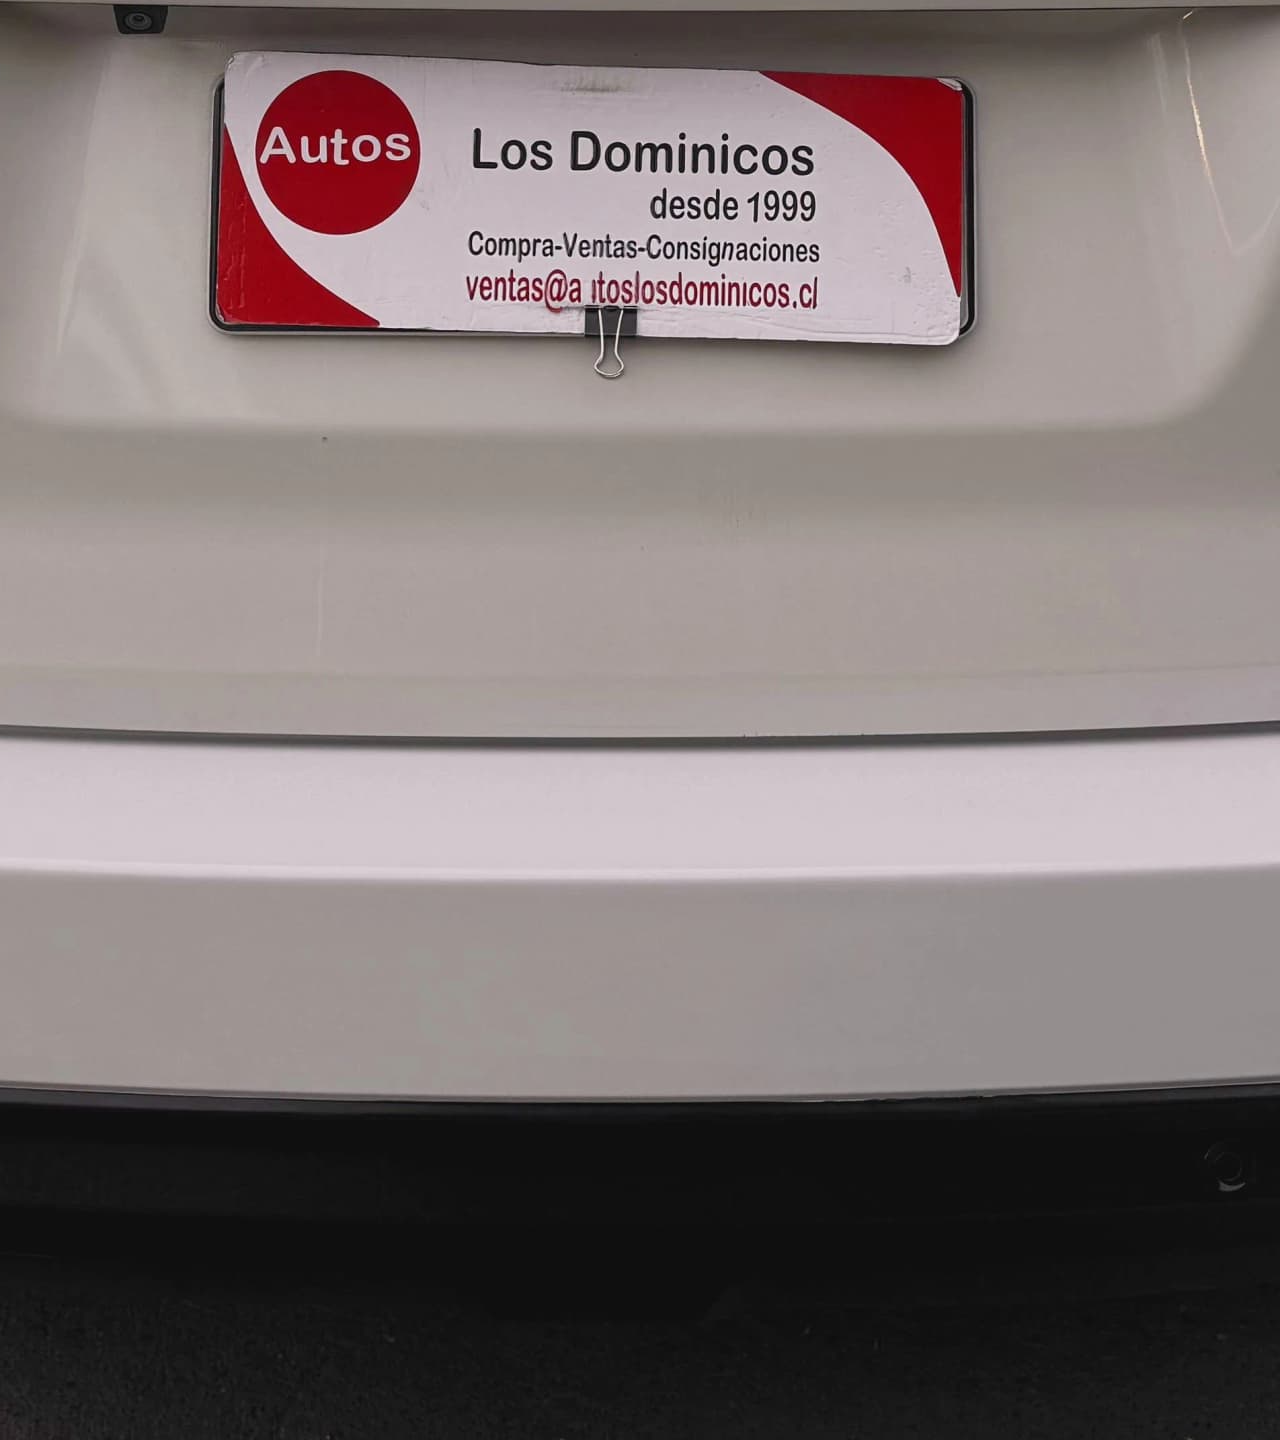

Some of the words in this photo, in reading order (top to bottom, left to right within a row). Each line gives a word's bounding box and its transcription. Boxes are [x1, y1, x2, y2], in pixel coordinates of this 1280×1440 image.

[260, 126, 412, 167] Autos
[472, 127, 554, 172] Los
[570, 129, 815, 177] Dominicos
[649, 187, 739, 221] desde
[746, 190, 817, 223] 1999
[467, 230, 821, 267] Compra-Ventas-Consignaciones
